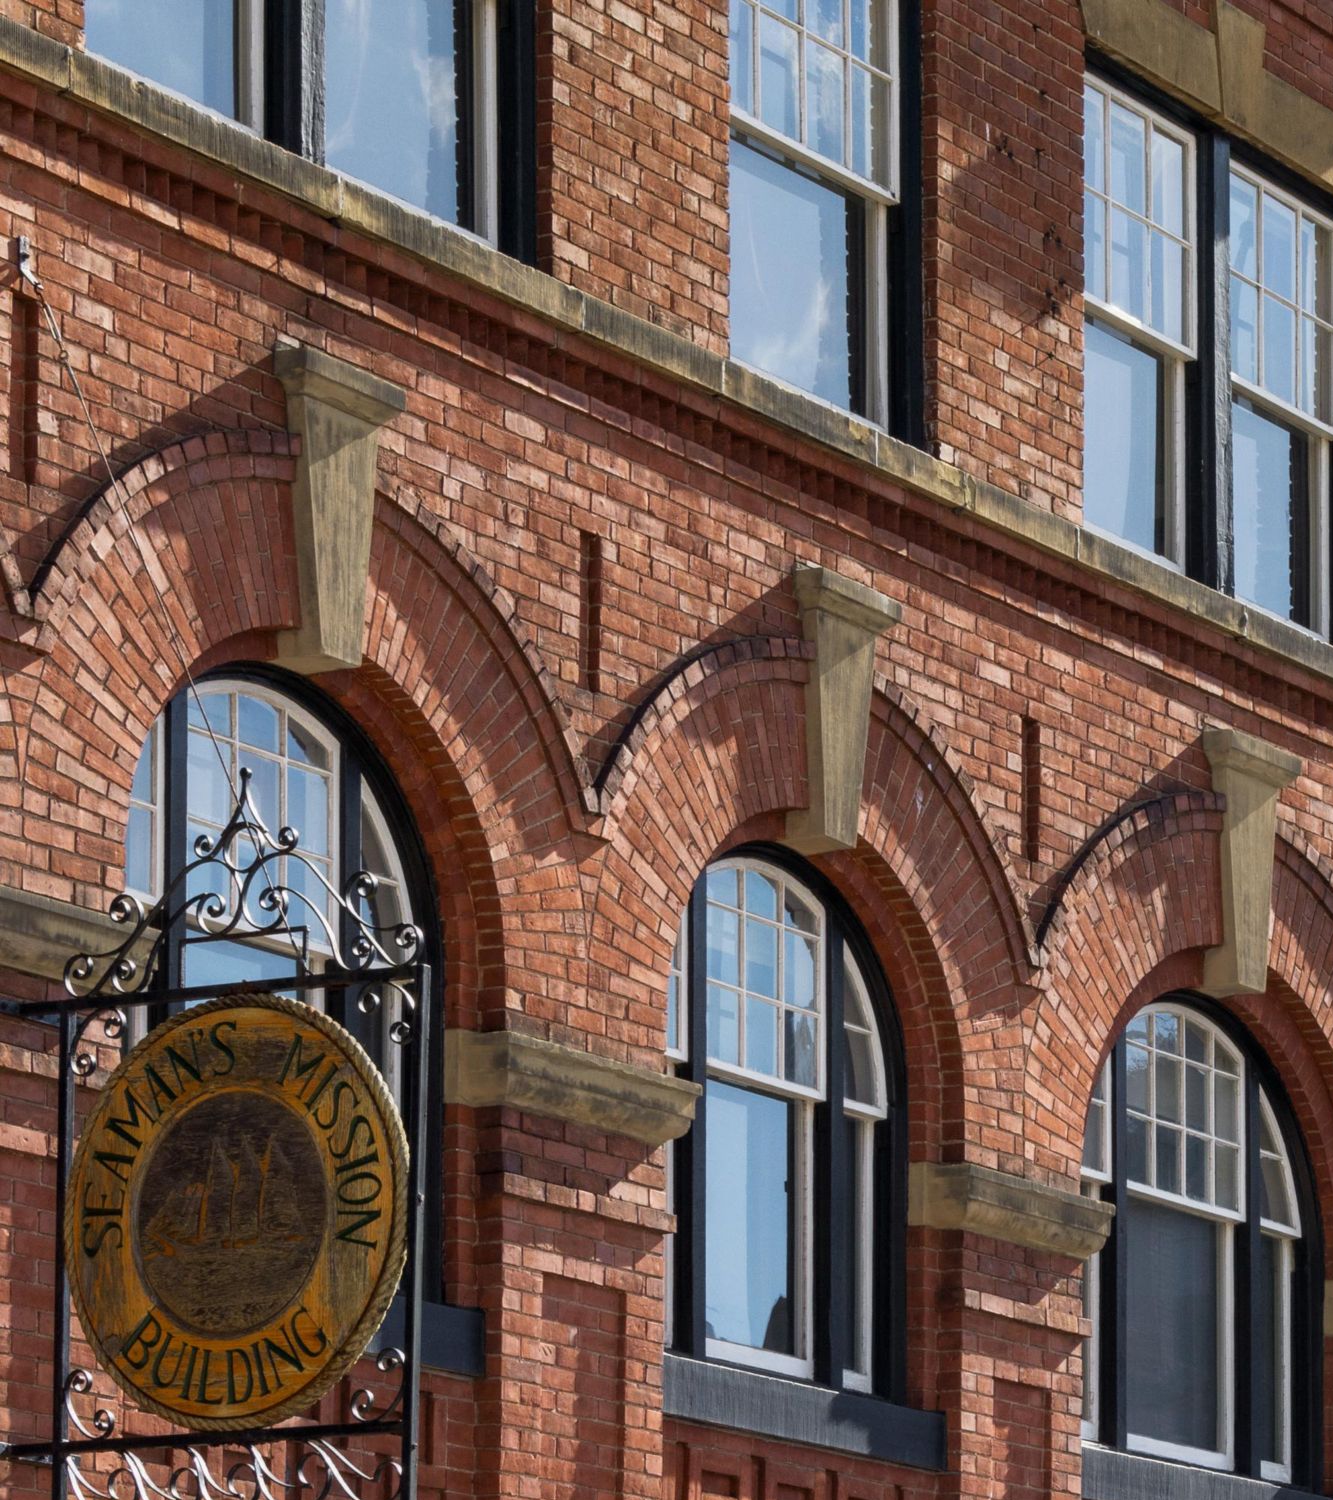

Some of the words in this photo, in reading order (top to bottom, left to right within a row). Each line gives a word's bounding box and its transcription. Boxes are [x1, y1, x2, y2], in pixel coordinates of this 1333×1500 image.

[82, 1020, 238, 1259] SEAMAN'S
[276, 1032, 382, 1250] MISSION
[118, 1306, 327, 1406] BUILDING
